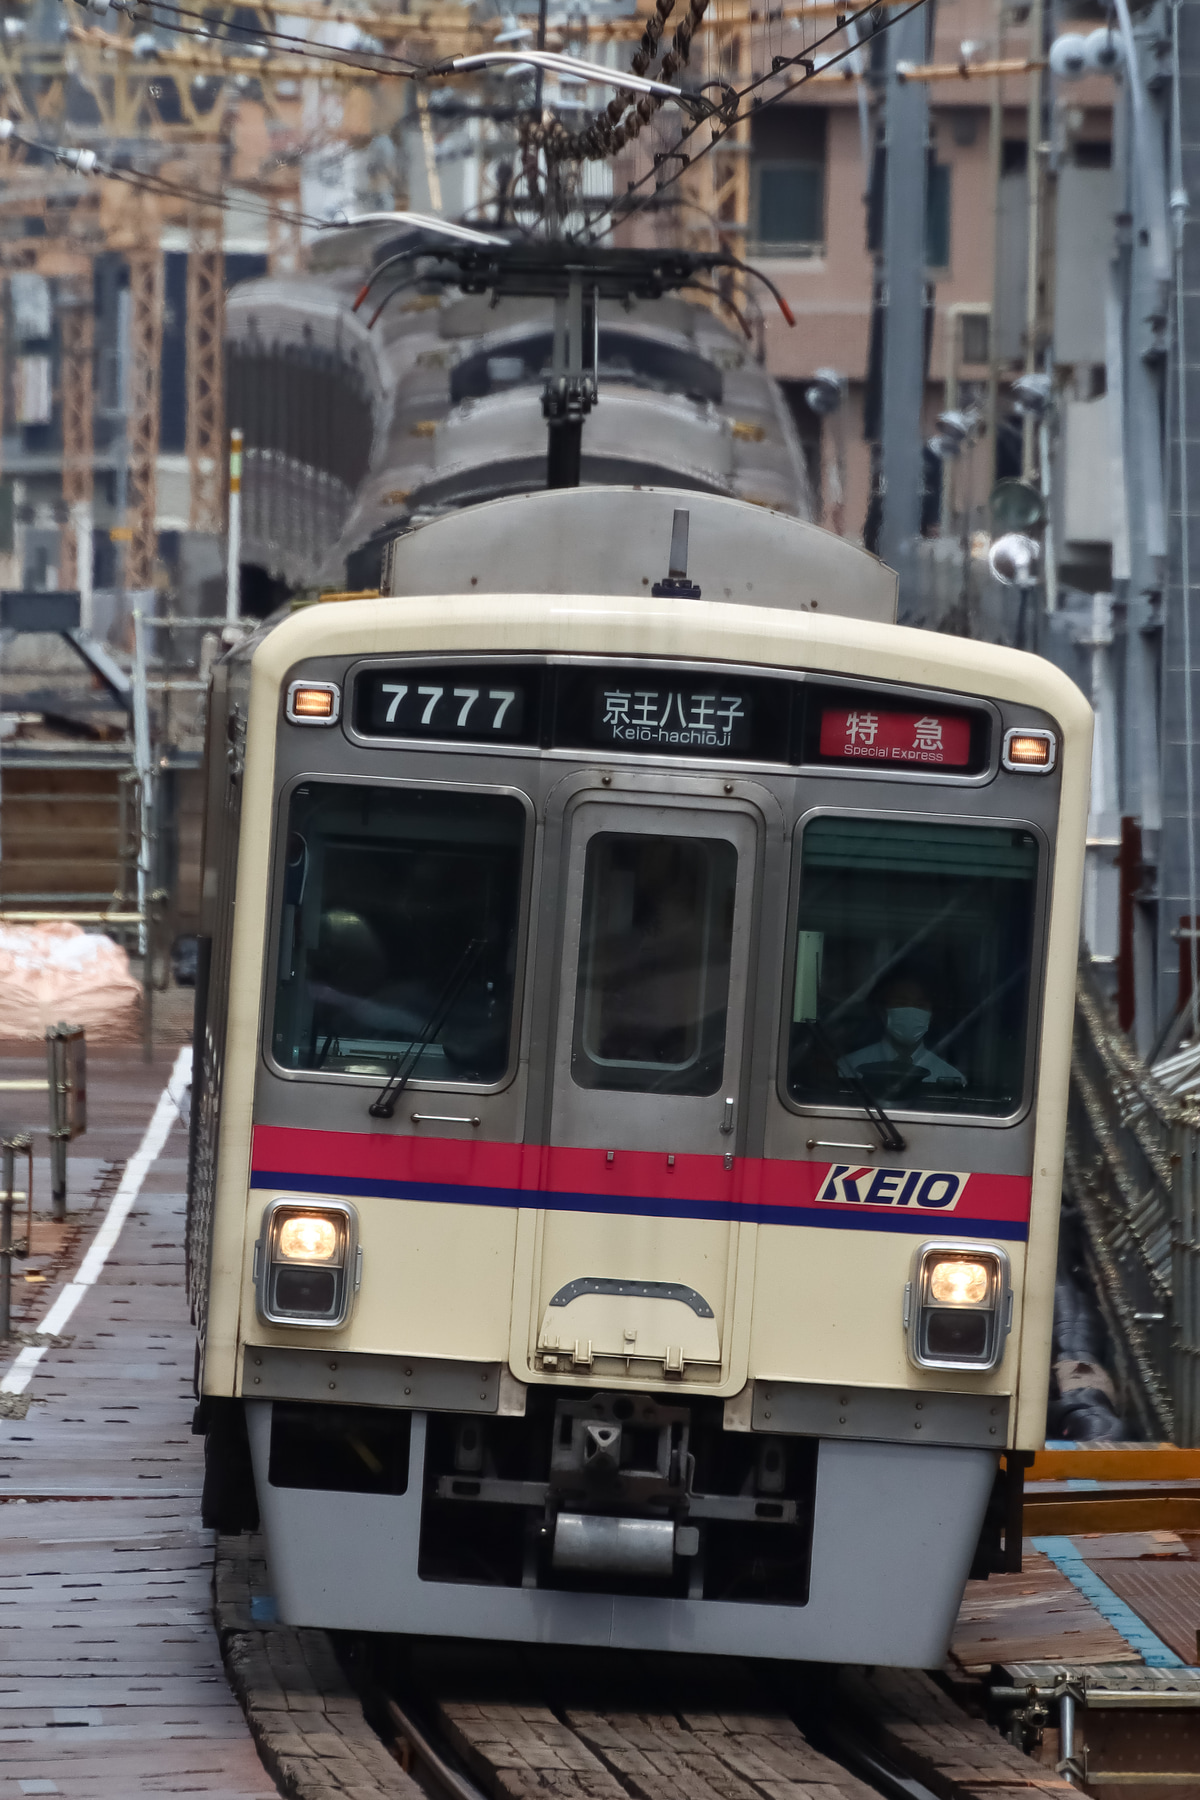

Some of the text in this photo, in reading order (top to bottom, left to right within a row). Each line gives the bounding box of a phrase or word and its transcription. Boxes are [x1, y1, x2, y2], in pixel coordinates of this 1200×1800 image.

[382, 684, 515, 728] 7777
[603, 689, 744, 732] 京王八王子
[844, 745, 943, 761] Special Express
[822, 1166, 960, 1208] KEIO
